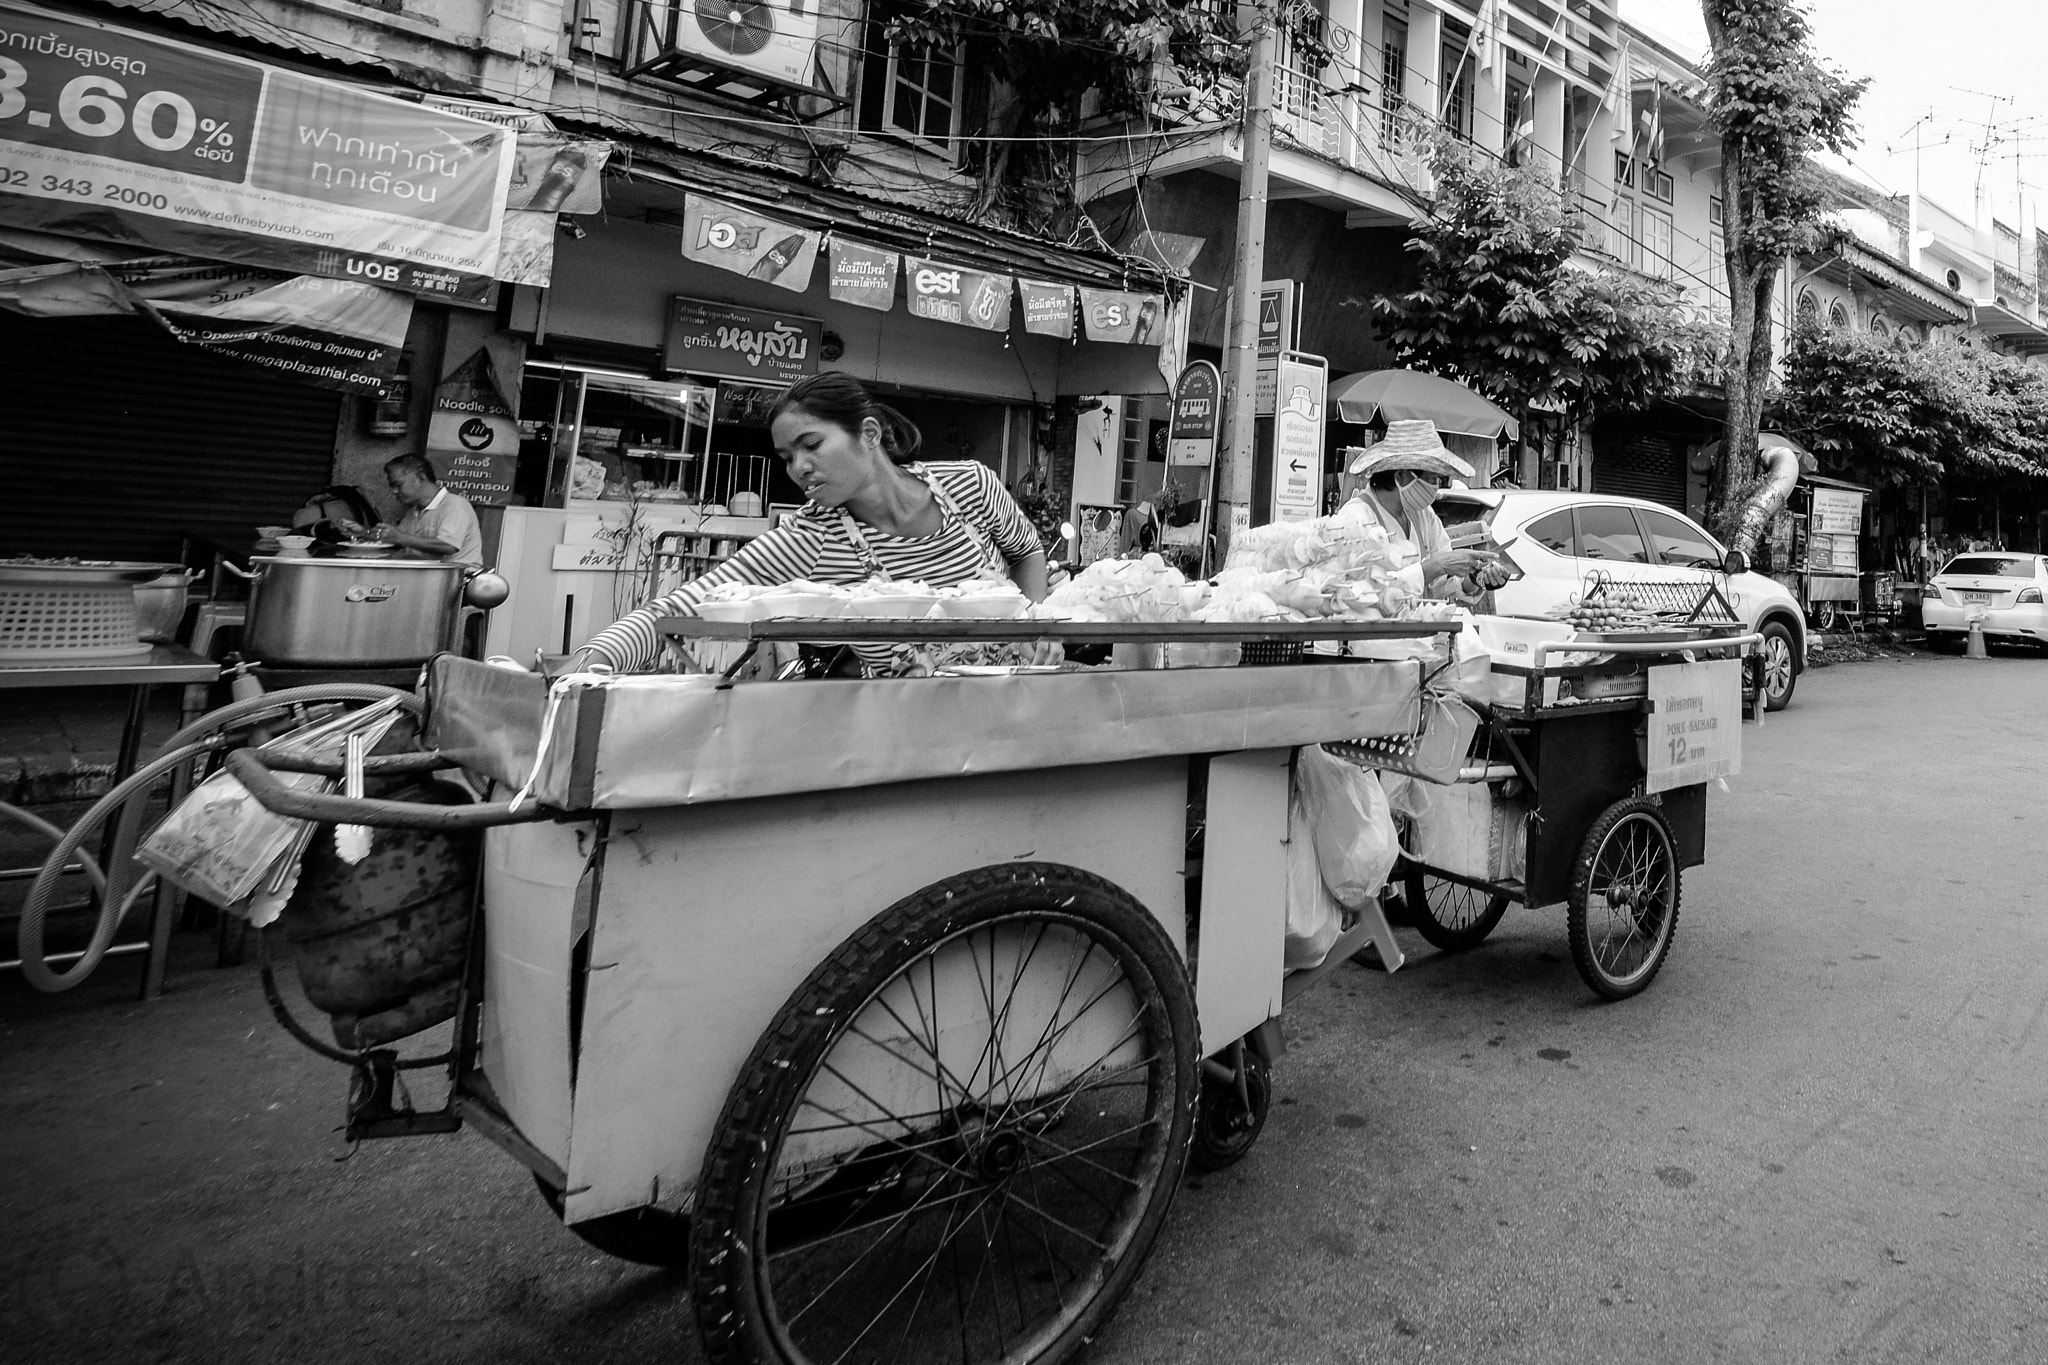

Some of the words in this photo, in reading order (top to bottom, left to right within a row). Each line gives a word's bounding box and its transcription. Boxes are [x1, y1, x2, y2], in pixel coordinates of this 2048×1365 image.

[194, 144, 234, 163] ต่อปี
[298, 125, 458, 178] ฝากเท่ากัน
[311, 161, 437, 203] ทุกเดือน
[41, 175, 93, 196] 343
[104, 184, 168, 210] 2000
[174, 203, 335, 242] www.definebyuob.com
[400, 246, 411, 255] 16
[415, 249, 455, 263] มิถุนายน
[458, 258, 482, 268] 2557
[346, 258, 400, 282] UOB
[916, 269, 960, 294] est
[412, 278, 458, 293] 大華銀行
[683, 332, 717, 349] ลูกชิ้น
[716, 320, 808, 367] หมูสับ
[439, 398, 485, 412] Noodle
[448, 469, 493, 479] กระเพาะ
[1668, 737, 1687, 765] 12
